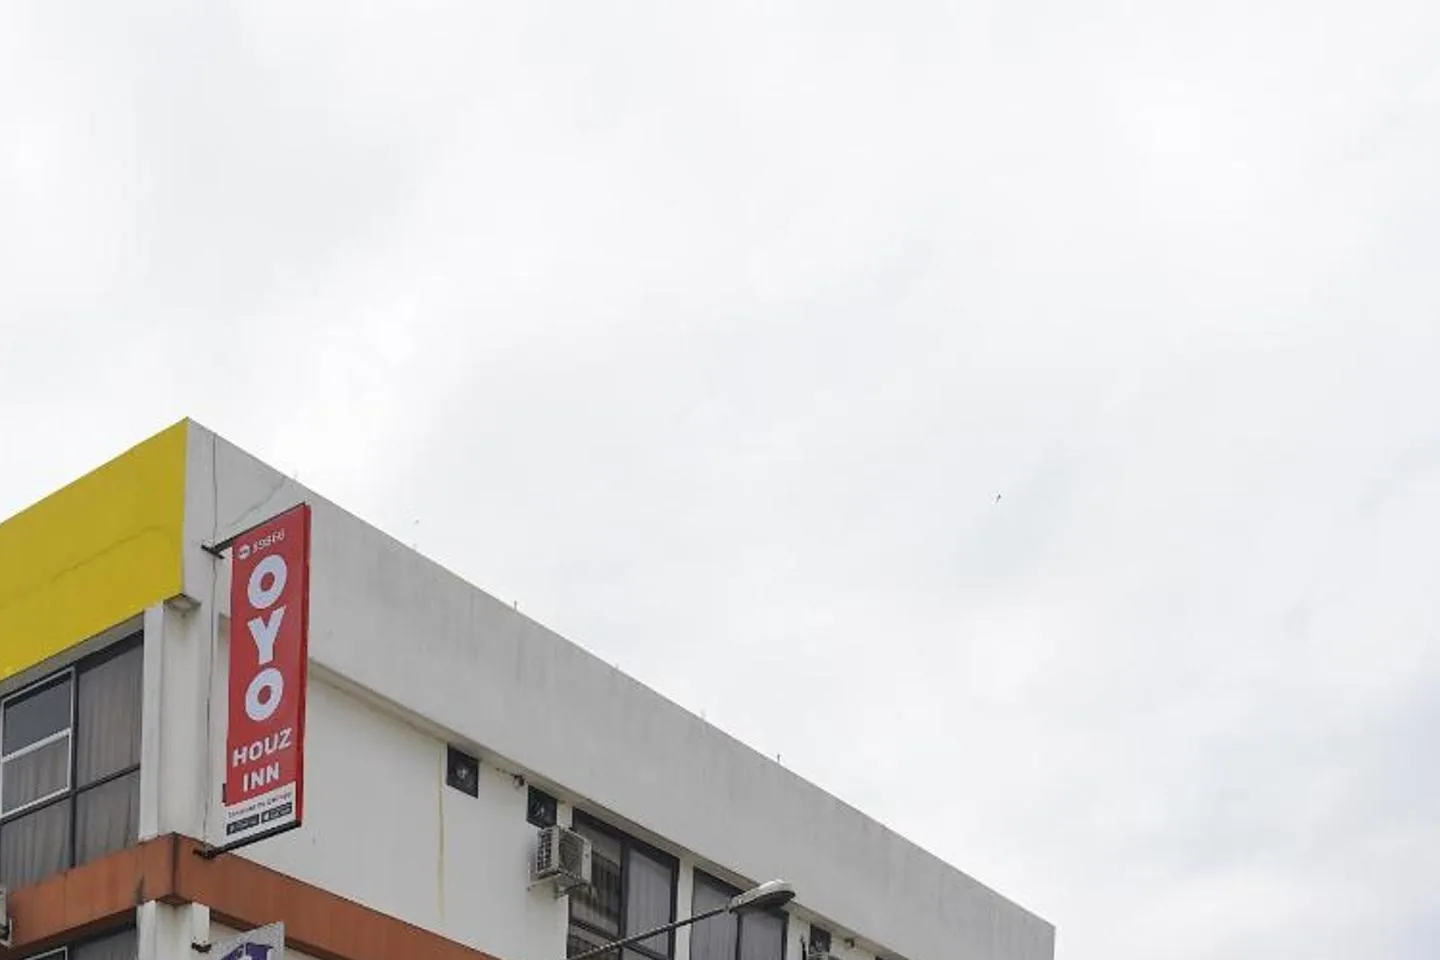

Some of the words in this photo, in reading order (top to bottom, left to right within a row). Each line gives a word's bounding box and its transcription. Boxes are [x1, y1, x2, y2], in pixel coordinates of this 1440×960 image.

[245, 554, 287, 722] OYO
[232, 728, 293, 767] HOUZ
[243, 761, 280, 792] INN
